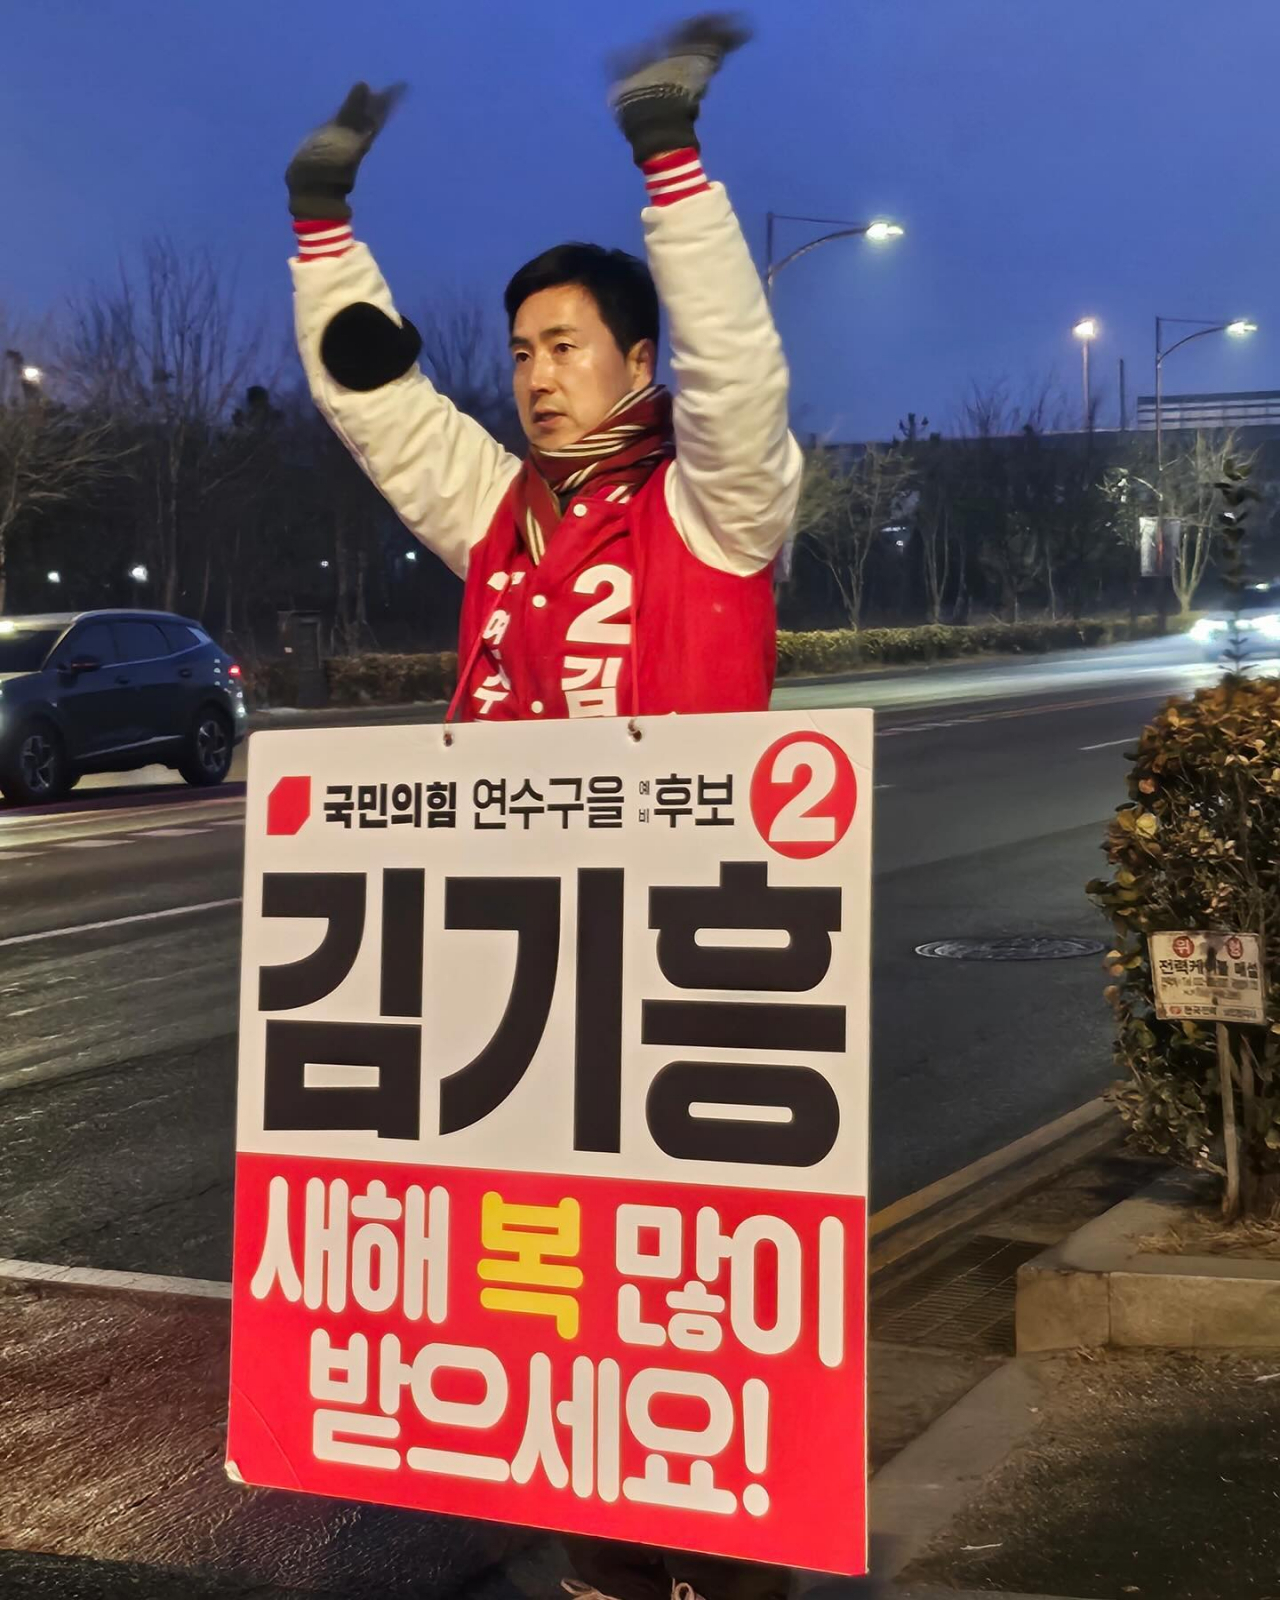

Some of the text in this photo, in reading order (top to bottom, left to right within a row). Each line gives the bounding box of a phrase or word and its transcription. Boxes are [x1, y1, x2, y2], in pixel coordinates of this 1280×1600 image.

[566, 564, 633, 645] 2
[562, 656, 623, 718] 김
[323, 781, 456, 829] 국민의힘
[473, 776, 624, 829] 연수구을
[653, 773, 734, 828] 후보
[768, 740, 838, 842] 2
[258, 861, 846, 1168] 김기흥
[250, 1175, 844, 1368] 새해 복 많이
[309, 1328, 770, 1517] 받으세요!
